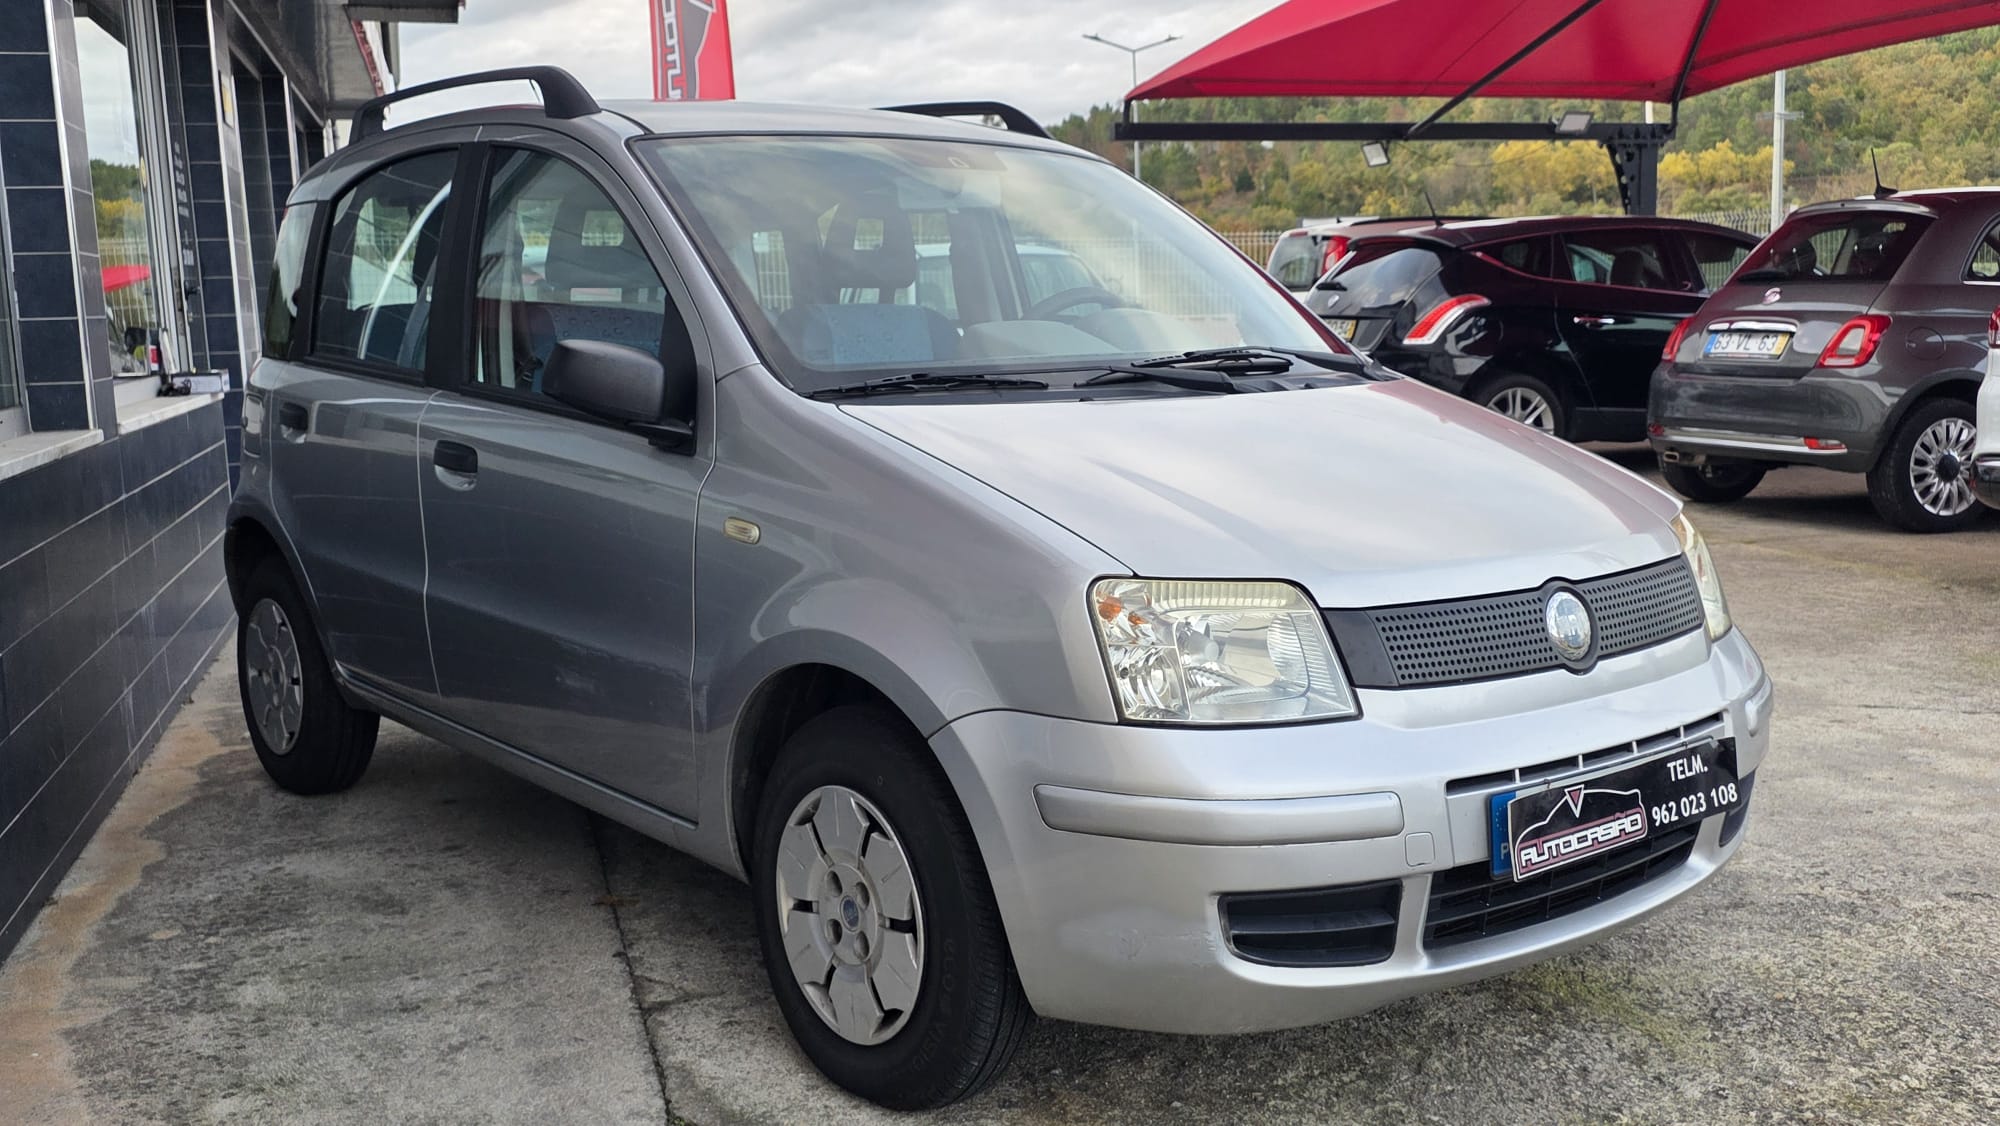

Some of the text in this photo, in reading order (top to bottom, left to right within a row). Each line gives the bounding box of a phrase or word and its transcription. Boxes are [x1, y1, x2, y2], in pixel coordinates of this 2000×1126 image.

[1667, 754, 1708, 781] TELM.
[1652, 783, 1738, 826] 962 023 108
